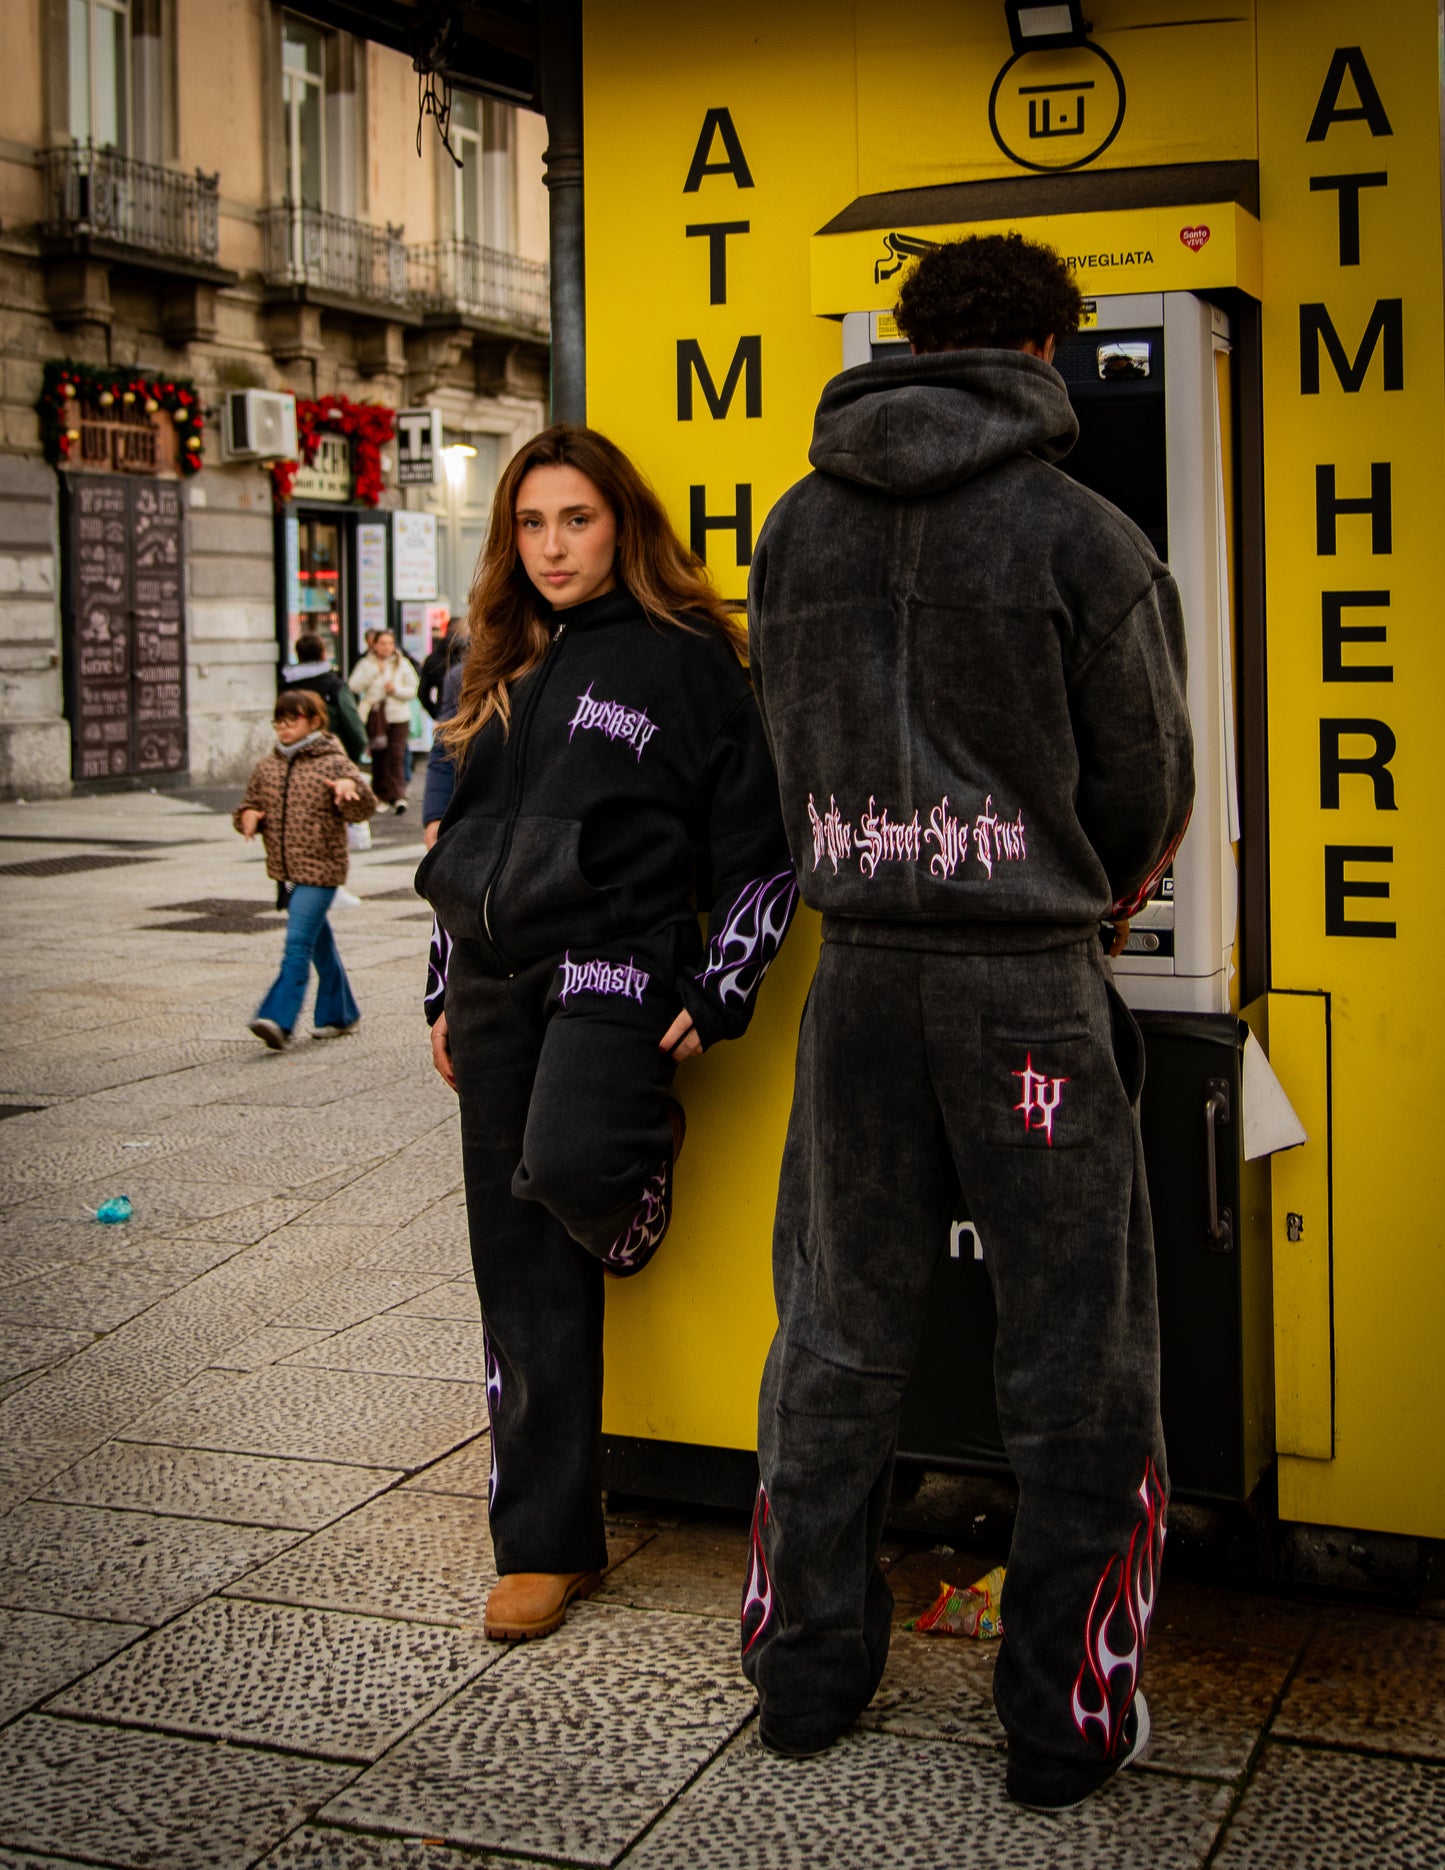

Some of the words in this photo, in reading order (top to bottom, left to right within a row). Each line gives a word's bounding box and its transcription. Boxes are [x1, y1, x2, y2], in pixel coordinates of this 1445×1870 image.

[676, 106, 763, 422] ATM
[1182, 229, 1208, 240] Santo
[1186, 238, 1206, 247] VIVE
[1299, 46, 1405, 397] ATM
[567, 680, 661, 764] DYNASTY
[1315, 461, 1399, 939] HERE
[853, 794, 921, 880] Street
[923, 794, 969, 881] We
[973, 794, 1027, 881] Trust
[558, 949, 651, 1009] DYNASTY
